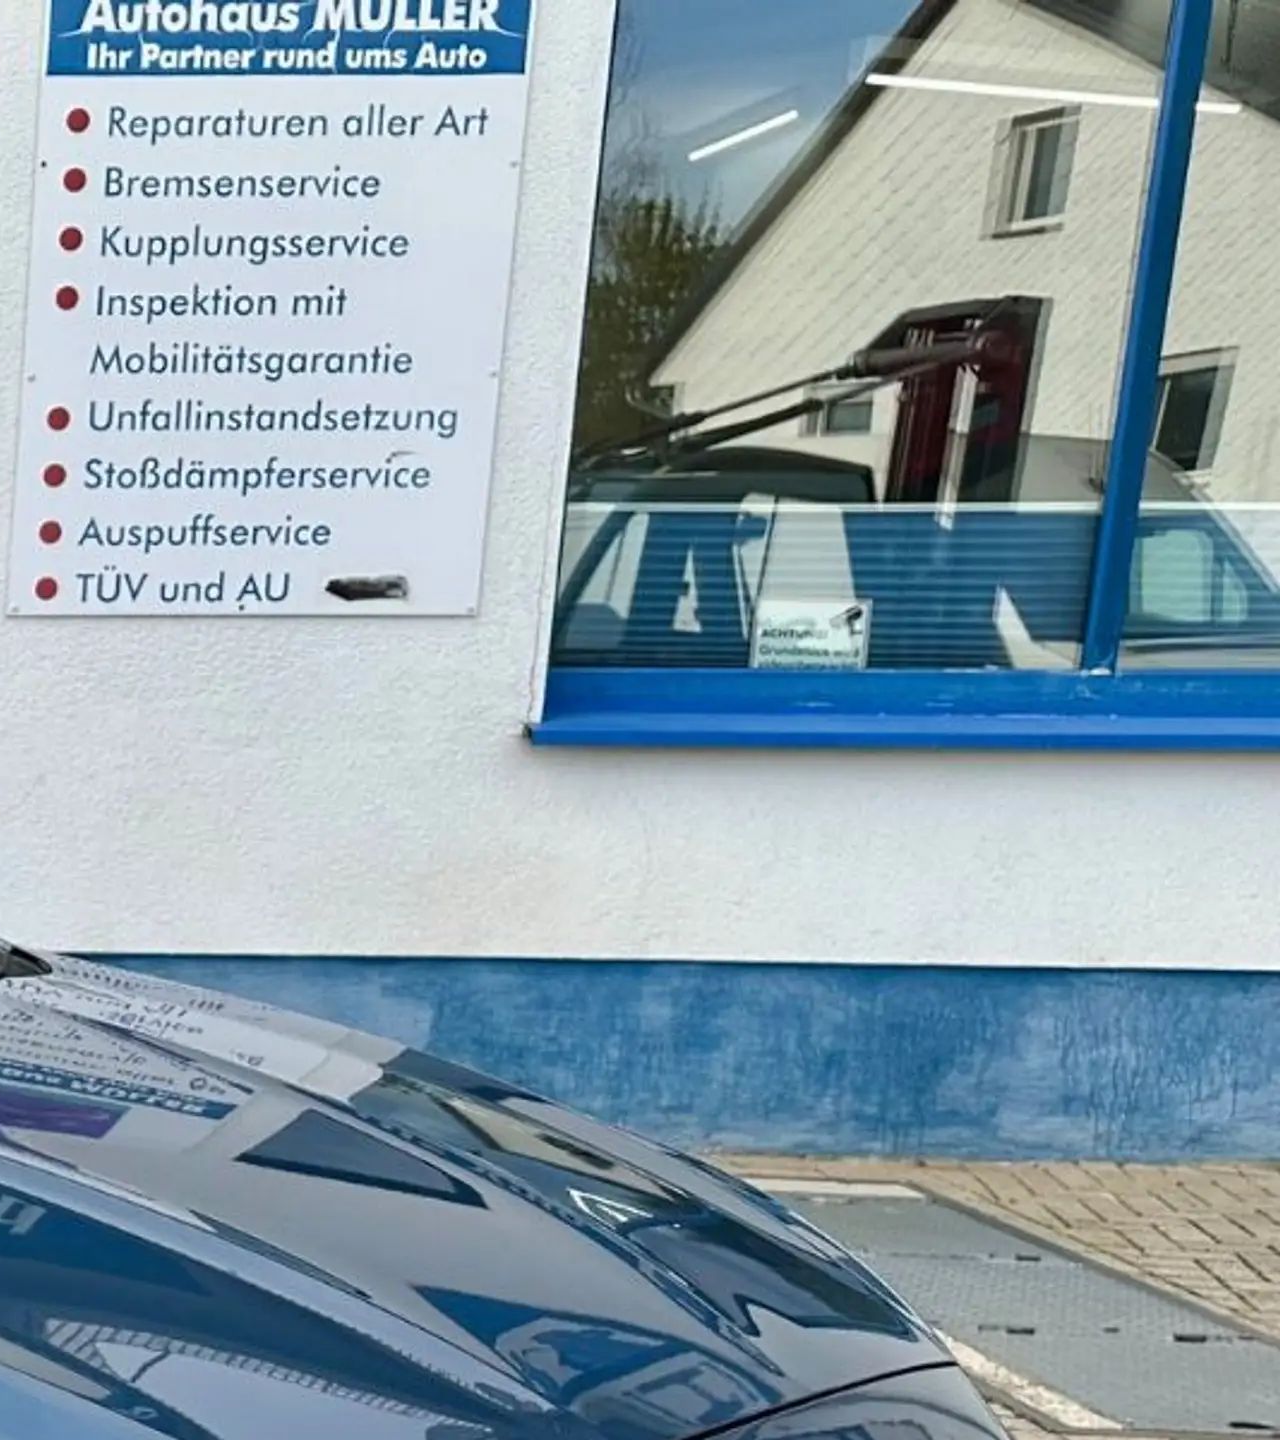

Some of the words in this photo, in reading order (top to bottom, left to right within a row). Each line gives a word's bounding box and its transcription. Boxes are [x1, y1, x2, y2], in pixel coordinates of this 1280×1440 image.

[79, 0, 300, 33] Autohaus
[87, 42, 132, 68] Ihr
[141, 42, 252, 69] Partner
[263, 42, 335, 69] rund
[345, 47, 407, 68] ums
[414, 43, 487, 69] Auto
[107, 107, 327, 144] Reparaturen
[342, 104, 423, 136] aller
[435, 107, 489, 136] Art
[103, 165, 380, 199] Bremsenservice
[100, 226, 409, 265] Kupplungsservice
[96, 286, 277, 323] Inspektion
[292, 287, 347, 316] mit
[90, 344, 413, 380] Mobilitätsgarantie
[88, 401, 458, 438] Unfallinstandsetzung
[84, 458, 431, 496] Stoßdämpferservice
[78, 515, 332, 553] Auspuffservice
[77, 565, 149, 603] TÜV
[160, 572, 224, 603] und
[237, 573, 291, 603] AU
